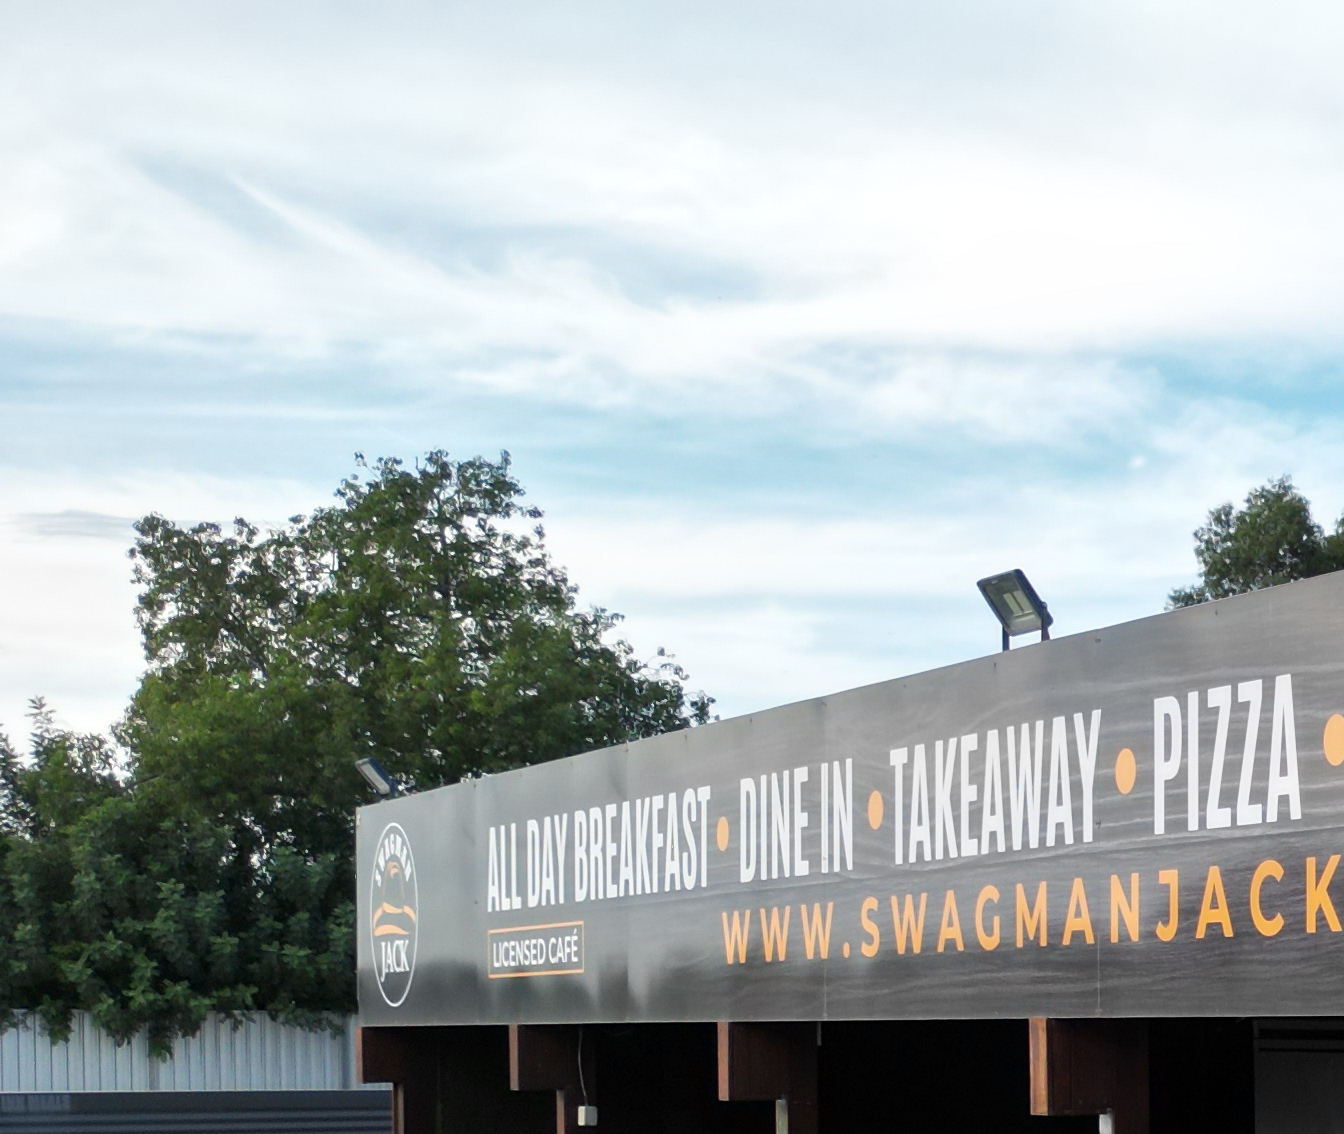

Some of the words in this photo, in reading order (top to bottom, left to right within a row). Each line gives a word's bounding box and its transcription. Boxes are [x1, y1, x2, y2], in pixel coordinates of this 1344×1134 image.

[487, 826, 522, 913] ALL
[526, 812, 568, 906] DAY
[574, 785, 711, 903] BREAKFAST
[739, 765, 809, 884] DINE
[820, 757, 854, 874] IN
[889, 709, 1102, 866] TAKEAWAY
[1153, 673, 1302, 836] PIZZA
[381, 939, 410, 983] JACK
[493, 934, 546, 968] LICENSED
[548, 928, 580, 965] CAFÉ
